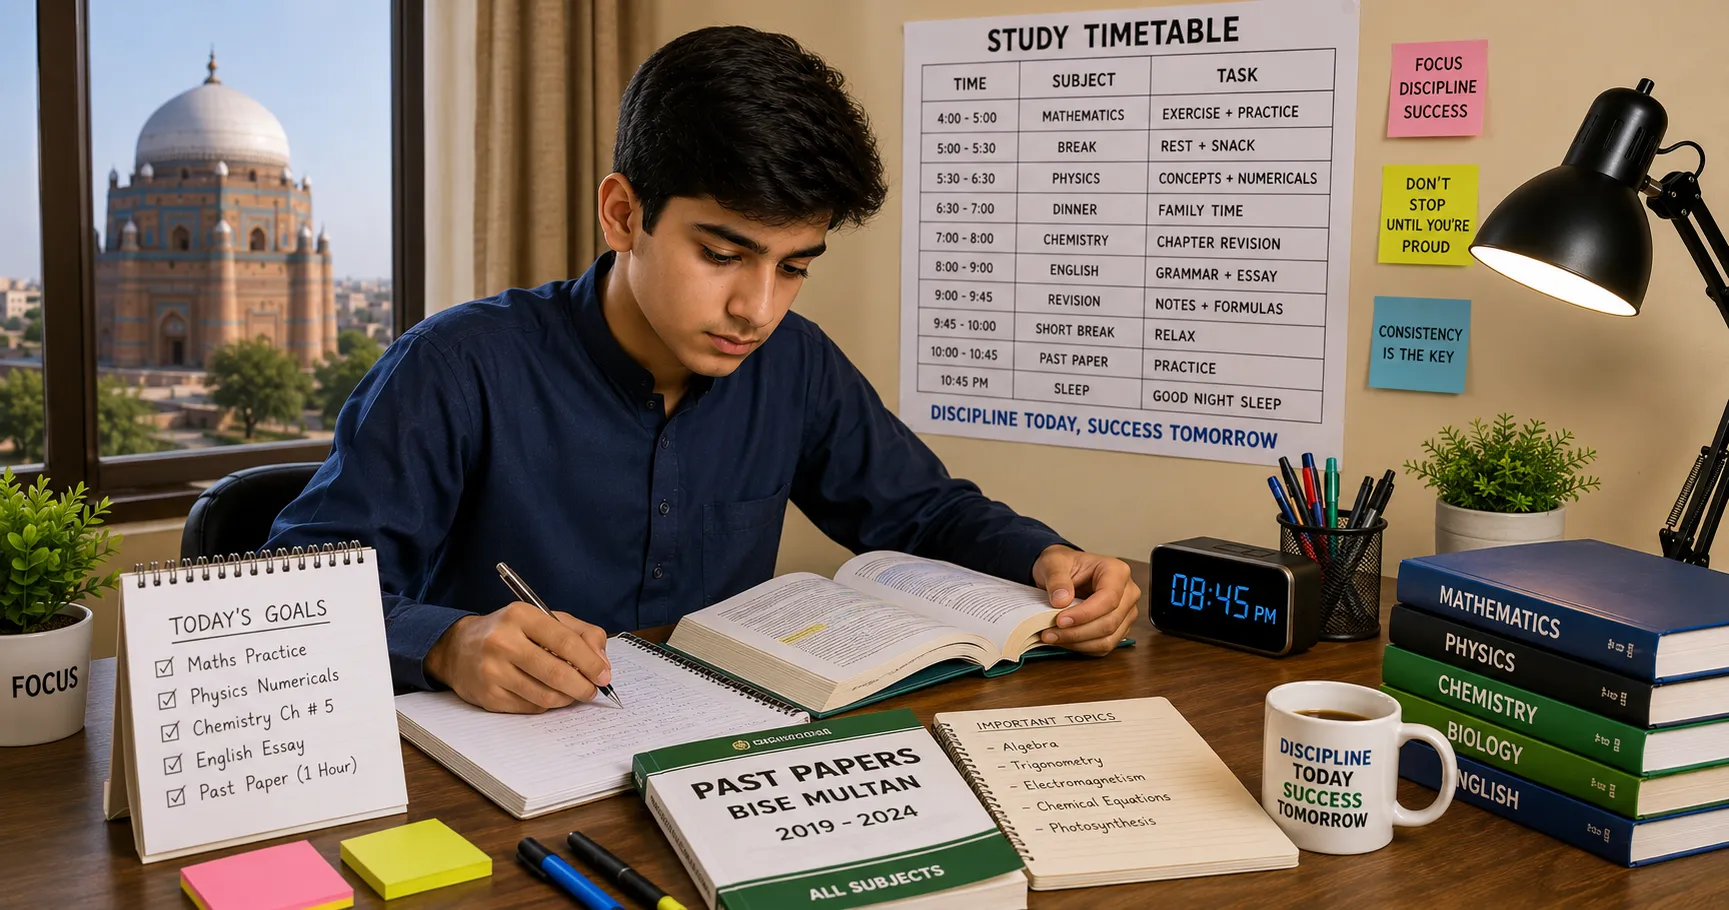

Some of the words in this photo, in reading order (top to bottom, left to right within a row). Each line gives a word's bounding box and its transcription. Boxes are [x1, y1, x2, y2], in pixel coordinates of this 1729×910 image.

[987, 26, 1069, 52] STUDY
[1084, 16, 1239, 48] TIMETABLE
[1416, 56, 1462, 71] FOCUS
[1052, 73, 1116, 88] SUBJECT
[1217, 68, 1258, 82] TASK
[954, 77, 986, 91] TIME
[1400, 80, 1477, 95] DISCIPLINE
[937, 112, 961, 124] 4:00
[974, 112, 997, 123] 5:00
[1042, 108, 1124, 122] MATHEMATICS
[1163, 107, 1220, 120] EXERCISE
[1226, 109, 1232, 117] +
[1238, 105, 1299, 119] PRACTICE
[1404, 104, 1468, 118] SUCCESS
[937, 143, 960, 154] 5:00
[973, 143, 996, 154] 5:30
[1058, 141, 1096, 153] BREAK
[1161, 140, 1192, 152] REST
[1199, 142, 1206, 150] +
[1212, 139, 1255, 152] SNACK
[936, 173, 960, 185] 5:30
[972, 173, 995, 184] 6:30
[1052, 173, 1100, 185] PHYSICS
[1159, 172, 1221, 185] CONCEPTS
[1238, 172, 1317, 185] NUMERICALS
[1406, 177, 1451, 190] DON'T
[936, 202, 959, 214] 6:30
[972, 203, 994, 214] 7:00
[1053, 203, 1097, 215] DINNER
[1158, 204, 1204, 217] FAMILY
[1211, 204, 1243, 217] TIME
[1410, 199, 1445, 211] STOP
[1387, 218, 1422, 231] UNTIL
[1426, 219, 1469, 232] YOU'RE
[936, 232, 959, 243] 7:00
[970, 233, 994, 244] 8:00
[1043, 233, 1108, 247] CHEMISTRY
[1157, 236, 1214, 249] CHAPTER
[1220, 237, 1281, 250] REVISION
[1402, 240, 1450, 253] PROUD
[935, 261, 958, 273] 8:00
[970, 262, 993, 274] 9:00
[1050, 264, 1099, 277] ENGLISH
[1156, 267, 1219, 281] GRAMMAR
[1237, 269, 1277, 283] ESSAY
[935, 290, 958, 301] 9:00
[970, 291, 993, 302] 9:45
[1048, 294, 1100, 307] REVISION
[1156, 299, 1196, 311] NOTES
[1201, 302, 1208, 310] +
[1214, 300, 1283, 315] FORMULAS
[934, 318, 956, 330] 9:45
[969, 319, 996, 331] 10:00
[1036, 323, 1073, 337] SHORT
[1078, 325, 1115, 338] BREAK
[1155, 329, 1195, 342] RELAX
[1379, 325, 1462, 342] CONSISTENCY
[931, 347, 958, 359] 10:00
[970, 349, 997, 361] 10:45
[1040, 353, 1067, 366] PAST
[1072, 355, 1108, 368] PAPER
[1383, 347, 1394, 360] IS
[1400, 348, 1424, 362] THE
[1430, 350, 1454, 363] KEY
[1154, 360, 1216, 374] PRACTICE
[940, 375, 968, 387] 10:45
[972, 377, 988, 388] PM
[1054, 383, 1090, 396] SLEEP
[1153, 390, 1188, 404] GOOD
[1195, 393, 1234, 407] NIGHT
[1241, 395, 1281, 410] SLEEP
[931, 404, 1018, 427] DISCIPLINE
[1024, 413, 1081, 436] TODAY,
[1088, 418, 1162, 439] SUCCESS
[1171, 425, 1278, 449] TOMORROW
[1171, 574, 1249, 619] 08:45
[1254, 606, 1276, 624] PM
[169, 608, 251, 636] TODAY'S
[265, 600, 327, 623] GOALS
[1440, 585, 1560, 639] MATHEMATICS
[188, 653, 236, 673] Maths
[246, 645, 307, 664] Practice
[1446, 633, 1515, 672] PHYSICS
[12, 666, 78, 698] FOCUS
[191, 685, 248, 709] Physics
[258, 668, 339, 694] Numericals
[1439, 675, 1538, 725] CHEMISTRY
[193, 711, 271, 736] Chemistry
[281, 704, 300, 720] Ch
[308, 702, 317, 715] #
[324, 699, 334, 714] 5
[977, 717, 1057, 730] IMPORTANT
[1065, 713, 1116, 723] TOPICS
[1003, 740, 1059, 755] Algebra
[1448, 720, 1523, 765] BIOLOGY
[196, 746, 252, 772] English
[262, 739, 305, 757] Essay
[1280, 737, 1371, 767] DISCIPLINE
[1010, 756, 1104, 773] Trigonometry
[200, 781, 235, 800] Past
[246, 773, 288, 793] Paper
[297, 766, 310, 783] (1
[319, 757, 357, 778] Hour)
[691, 770, 781, 800] PAST
[788, 748, 921, 782] PAPERS
[1293, 763, 1354, 788] TODAY
[1023, 774, 1146, 791] Electromagnetism
[1455, 768, 1519, 810] NGLISH
[727, 796, 796, 820] BISE
[802, 775, 921, 806] MULTAN
[1036, 797, 1100, 812] Chemical
[1101, 793, 1172, 809] Equations
[1283, 782, 1362, 808] SUCCESS
[1277, 799, 1368, 829] TOMORROW
[776, 819, 834, 841] 2019
[857, 804, 918, 827] 2024
[1048, 817, 1157, 835] Photosynthesis
[809, 884, 846, 901] ALL
[849, 865, 945, 893] SUBJECTS
